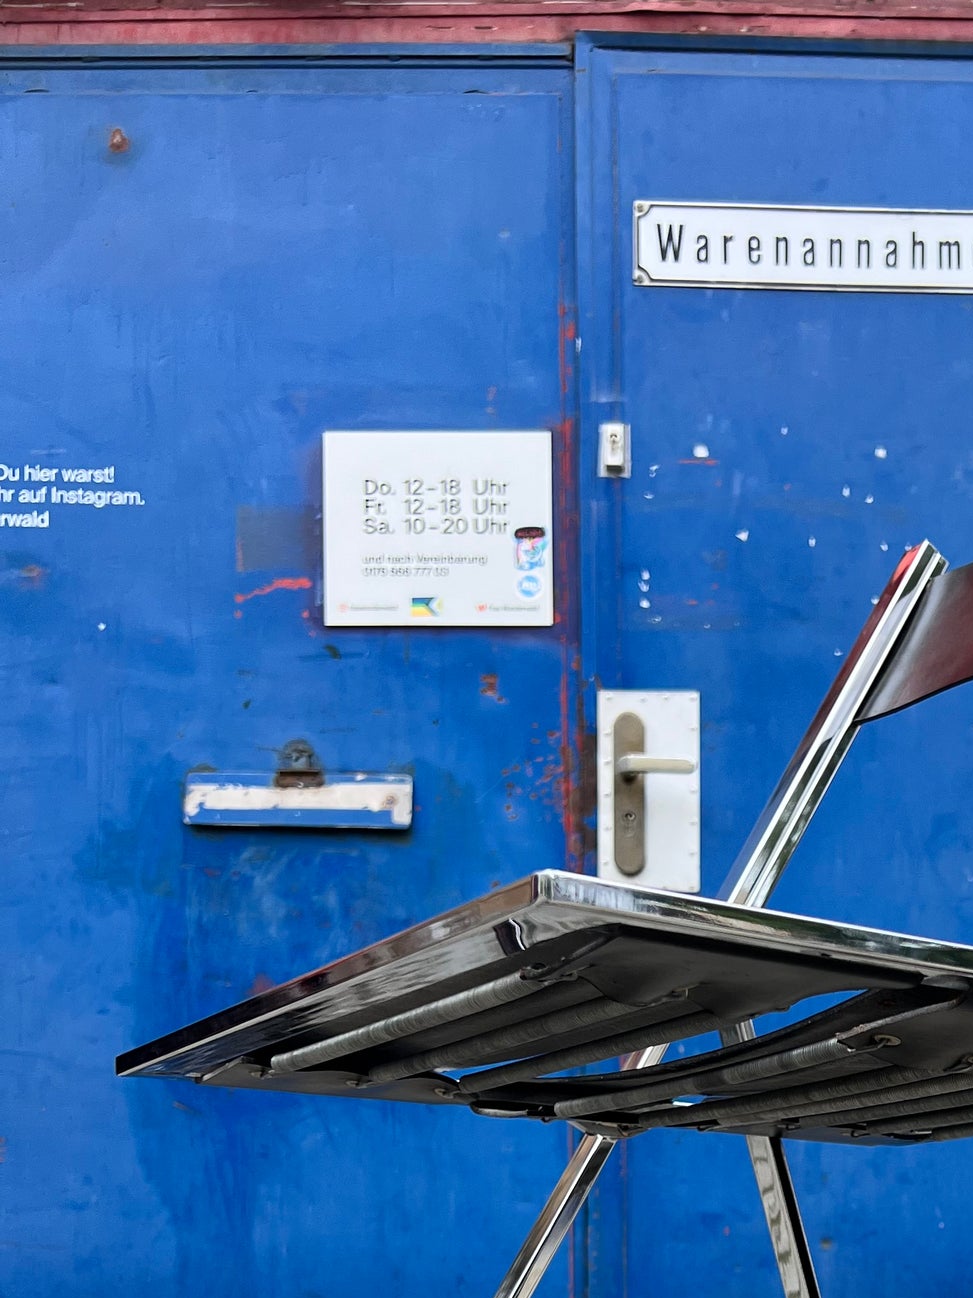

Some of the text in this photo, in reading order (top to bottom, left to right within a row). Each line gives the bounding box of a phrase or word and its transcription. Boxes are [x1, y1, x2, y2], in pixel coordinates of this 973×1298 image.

[23, 464, 59, 482] hier
[61, 466, 115, 483] warst!
[363, 479, 396, 496] Do.
[472, 479, 510, 496] Uhr
[18, 486, 48, 503] auf
[51, 487, 146, 508] Instagram.
[472, 499, 510, 516] Uhr
[363, 518, 396, 535] Sa.
[472, 518, 510, 535] Uhr
